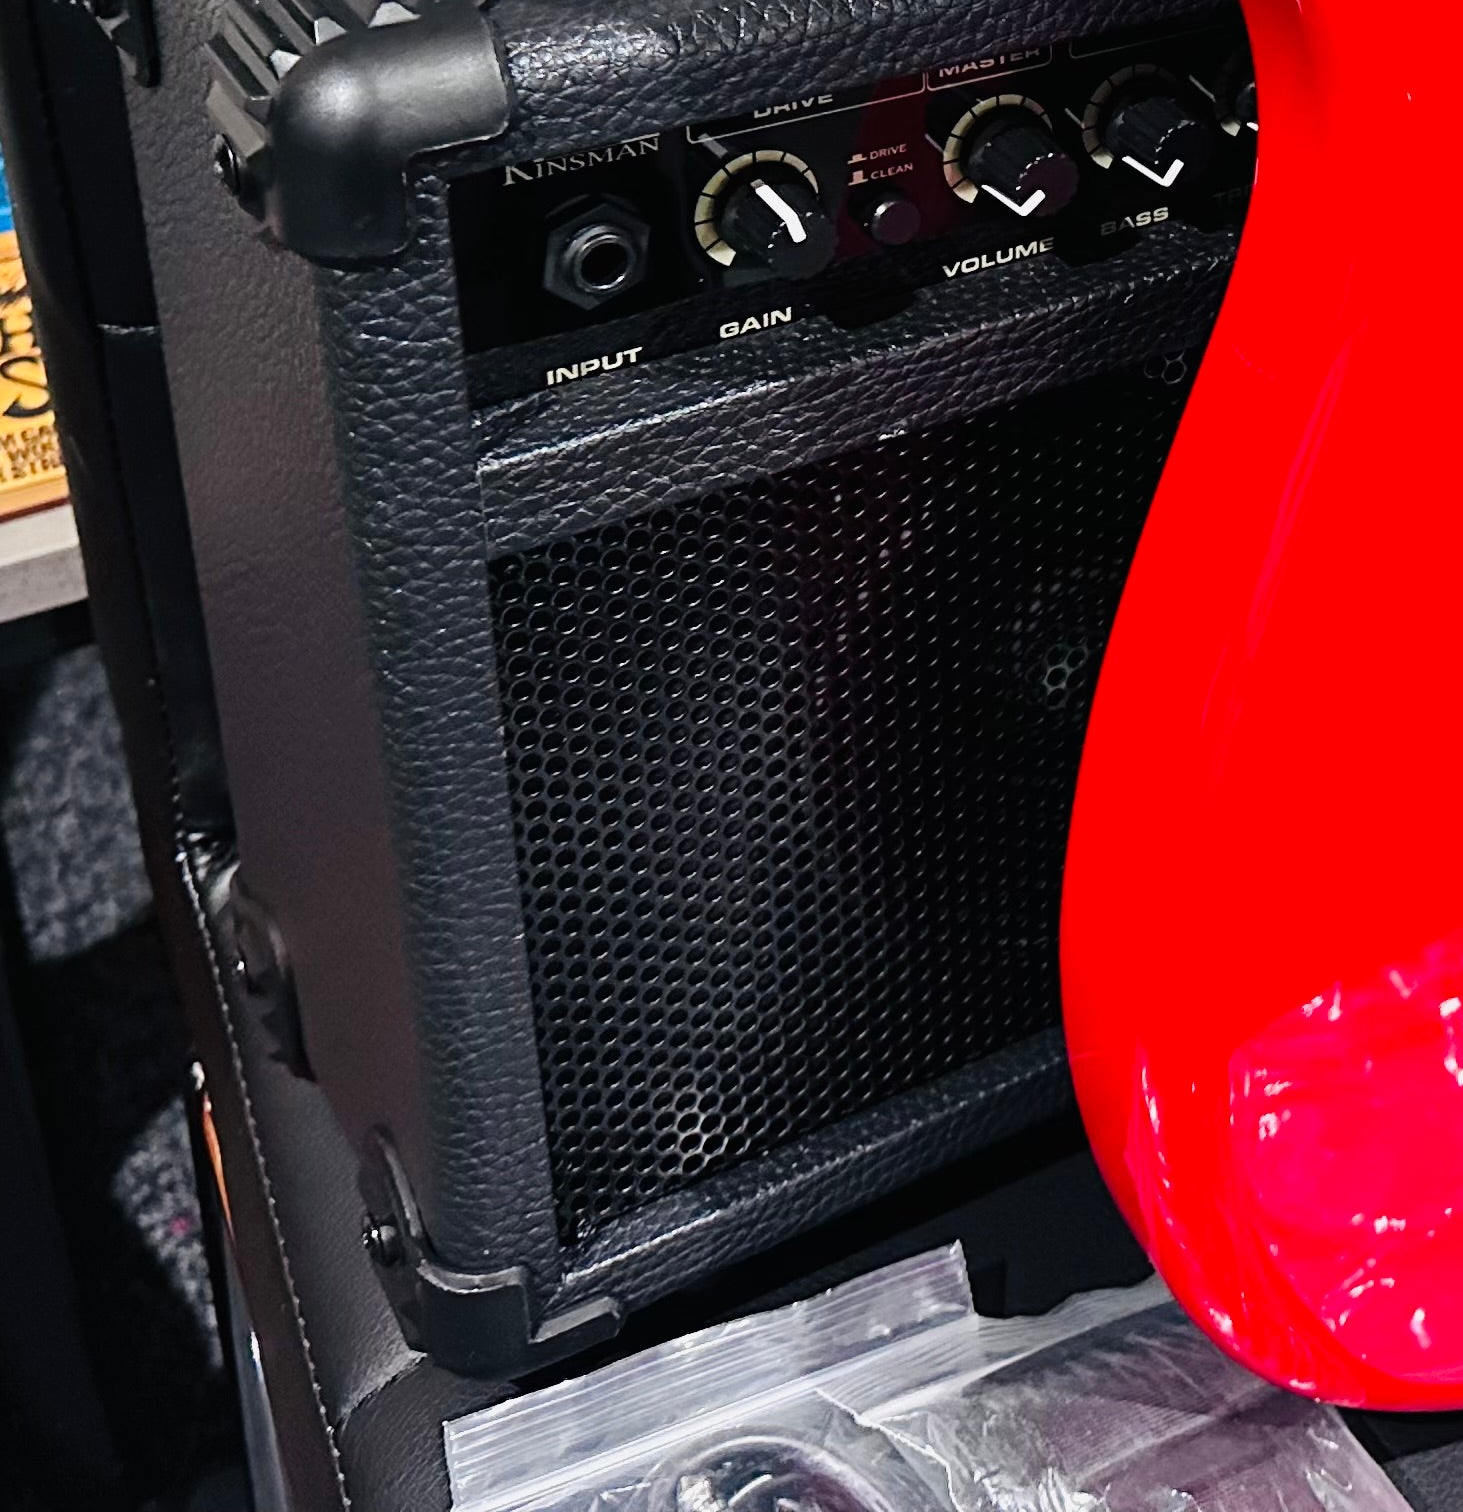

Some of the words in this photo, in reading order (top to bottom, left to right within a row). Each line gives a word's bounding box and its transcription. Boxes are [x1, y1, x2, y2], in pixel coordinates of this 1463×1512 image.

[502, 136, 661, 187] KINSMAN
[869, 143, 908, 161] DRIVE
[870, 162, 914, 181] CLEAN
[1100, 206, 1170, 237] BASS
[942, 237, 1055, 278] VOLUME
[719, 306, 793, 339] GAIN
[546, 346, 643, 386] INPUT
